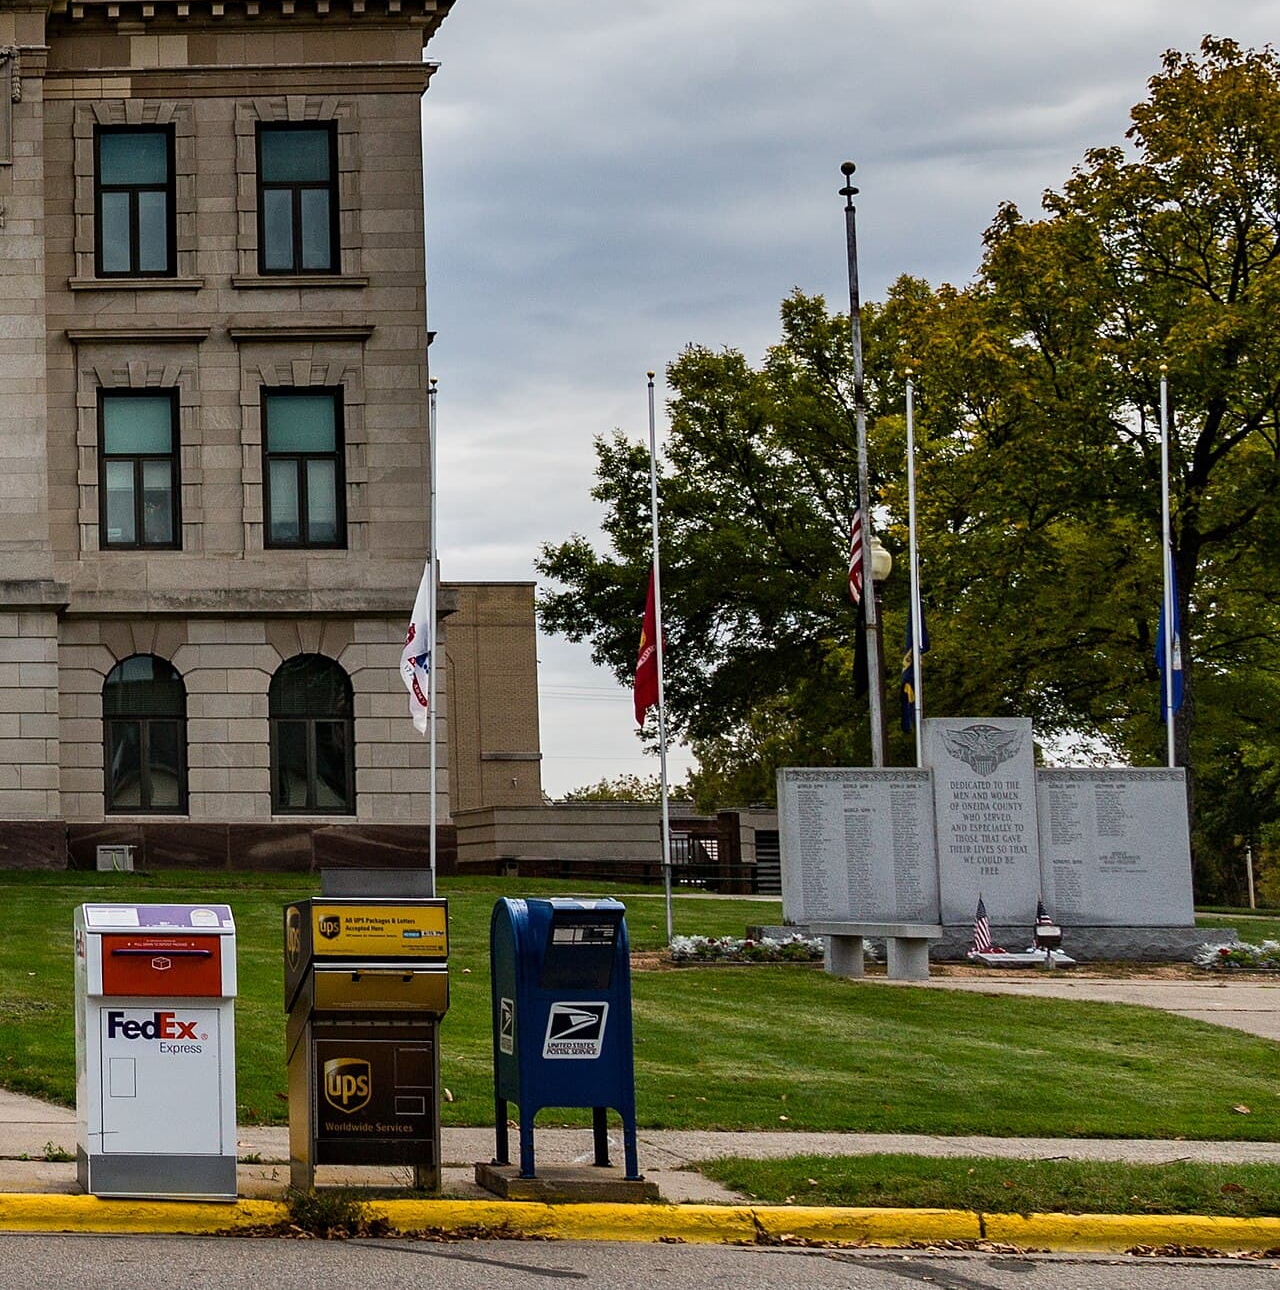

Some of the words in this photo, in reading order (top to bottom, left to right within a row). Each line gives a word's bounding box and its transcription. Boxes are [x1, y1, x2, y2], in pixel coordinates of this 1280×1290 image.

[950, 781, 991, 789] DEDICATED
[994, 781, 1002, 789] TO
[1006, 781, 1020, 789] THE
[963, 813, 980, 822] WHO
[983, 813, 1012, 822] SERVED,
[964, 856, 974, 864] WE
[977, 856, 1002, 864] COULD
[1005, 856, 1014, 864] BE
[981, 867, 999, 875] FREE
[320, 922, 339, 936] ups
[108, 1011, 198, 1040] FedEx
[160, 1042, 202, 1055] Express
[328, 1075, 368, 1105] ups
[325, 1122, 374, 1131] Worldwide
[375, 1123, 414, 1132] Services
